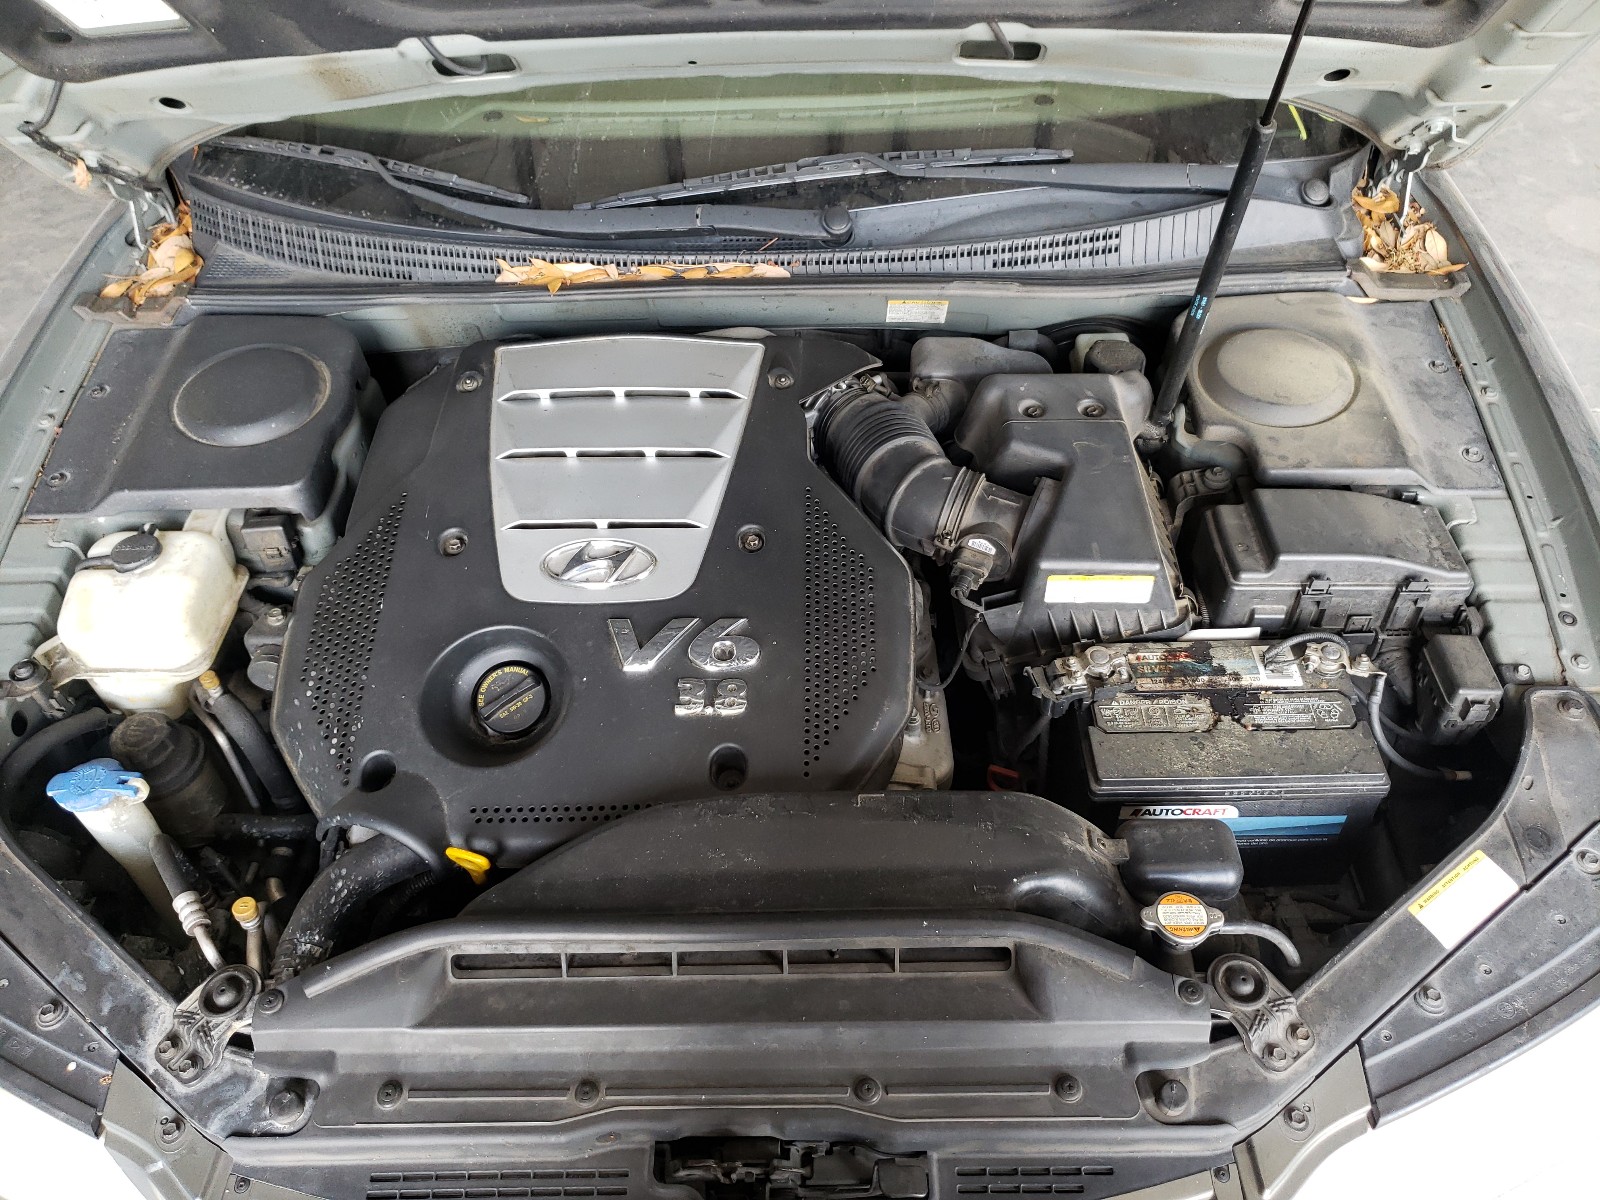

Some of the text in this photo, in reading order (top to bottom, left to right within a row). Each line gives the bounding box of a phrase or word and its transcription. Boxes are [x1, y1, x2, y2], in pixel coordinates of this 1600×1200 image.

[607, 617, 761, 672] V6
[480, 669, 503, 692] OWNER'S
[503, 666, 529, 676] MANUAL
[674, 677, 748, 716] 3.8
[1141, 807, 1228, 817] AUTOCRAFT
